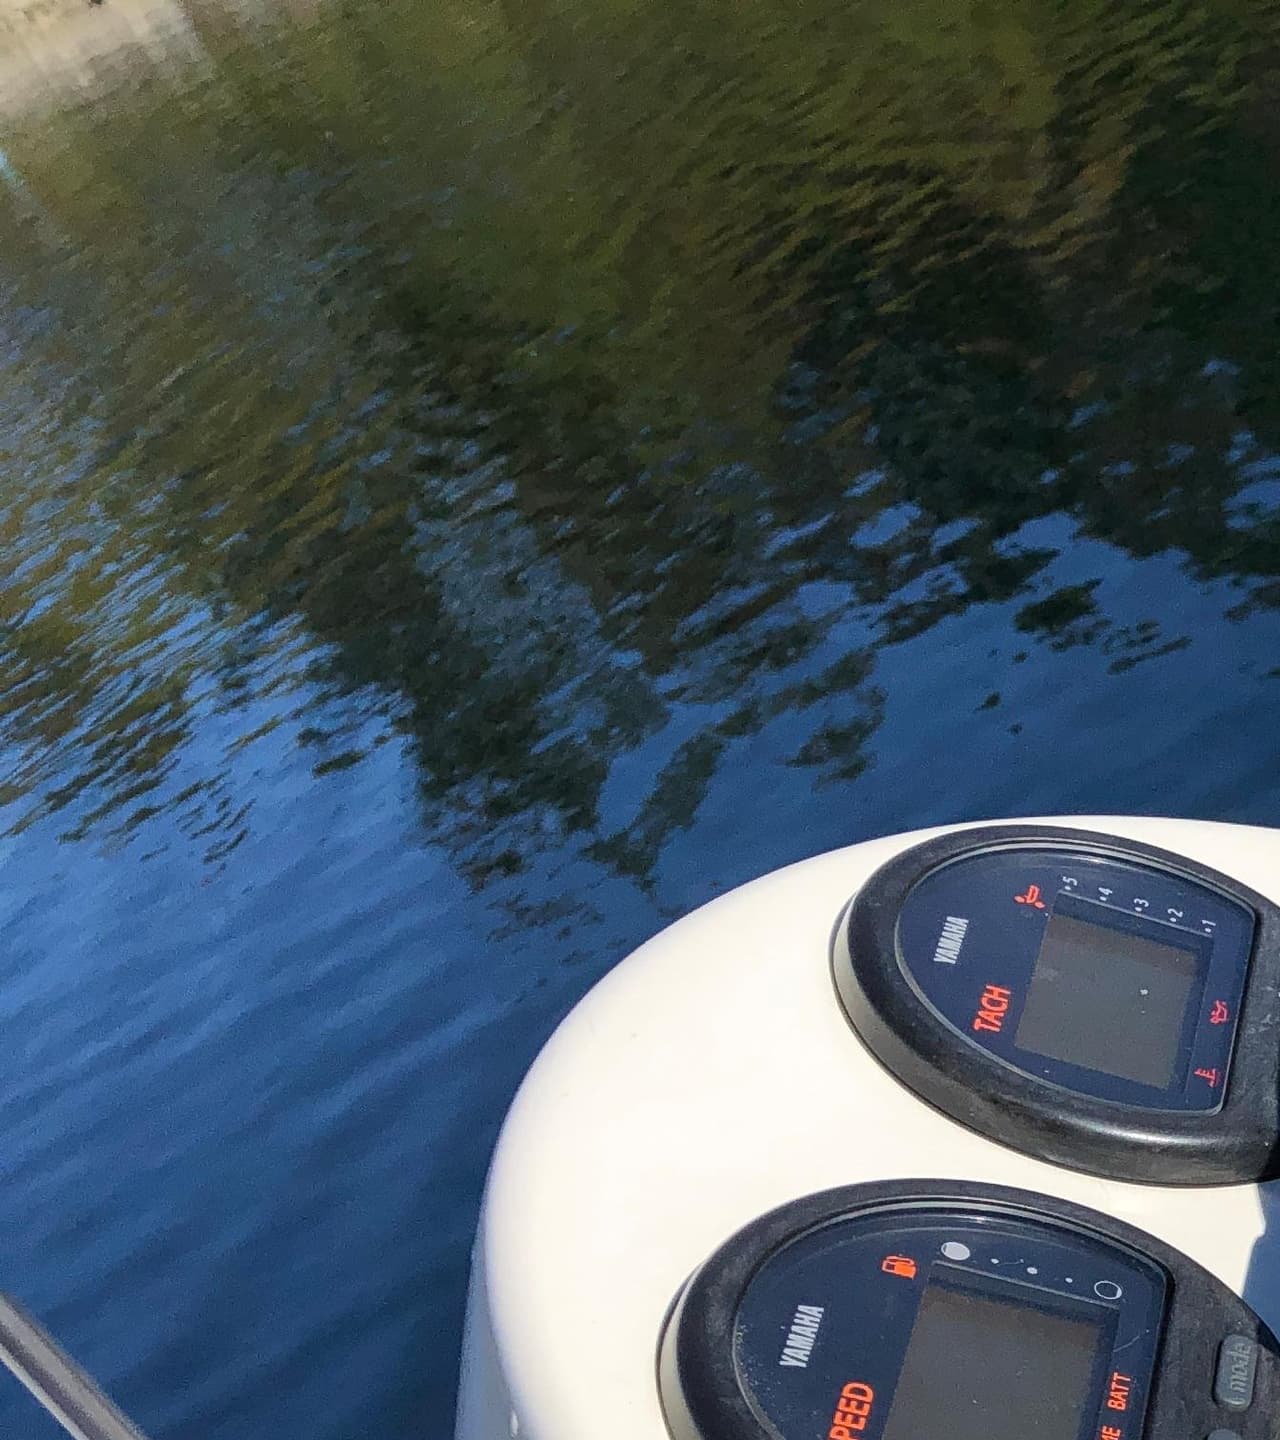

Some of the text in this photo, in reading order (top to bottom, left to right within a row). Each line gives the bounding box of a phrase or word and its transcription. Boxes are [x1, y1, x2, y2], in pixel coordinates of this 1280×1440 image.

[1062, 876, 1078, 887] 5
[1098, 887, 1113, 896] 4
[1133, 898, 1149, 908] 3
[1167, 908, 1184, 918] 2
[1201, 919, 1217, 927] 1
[932, 916, 970, 964] YAMAHA
[973, 983, 1012, 1033] TACH
[779, 1304, 825, 1368] YAMAHA
[1226, 1342, 1252, 1393] mode
[1107, 1371, 1132, 1412] BATT
